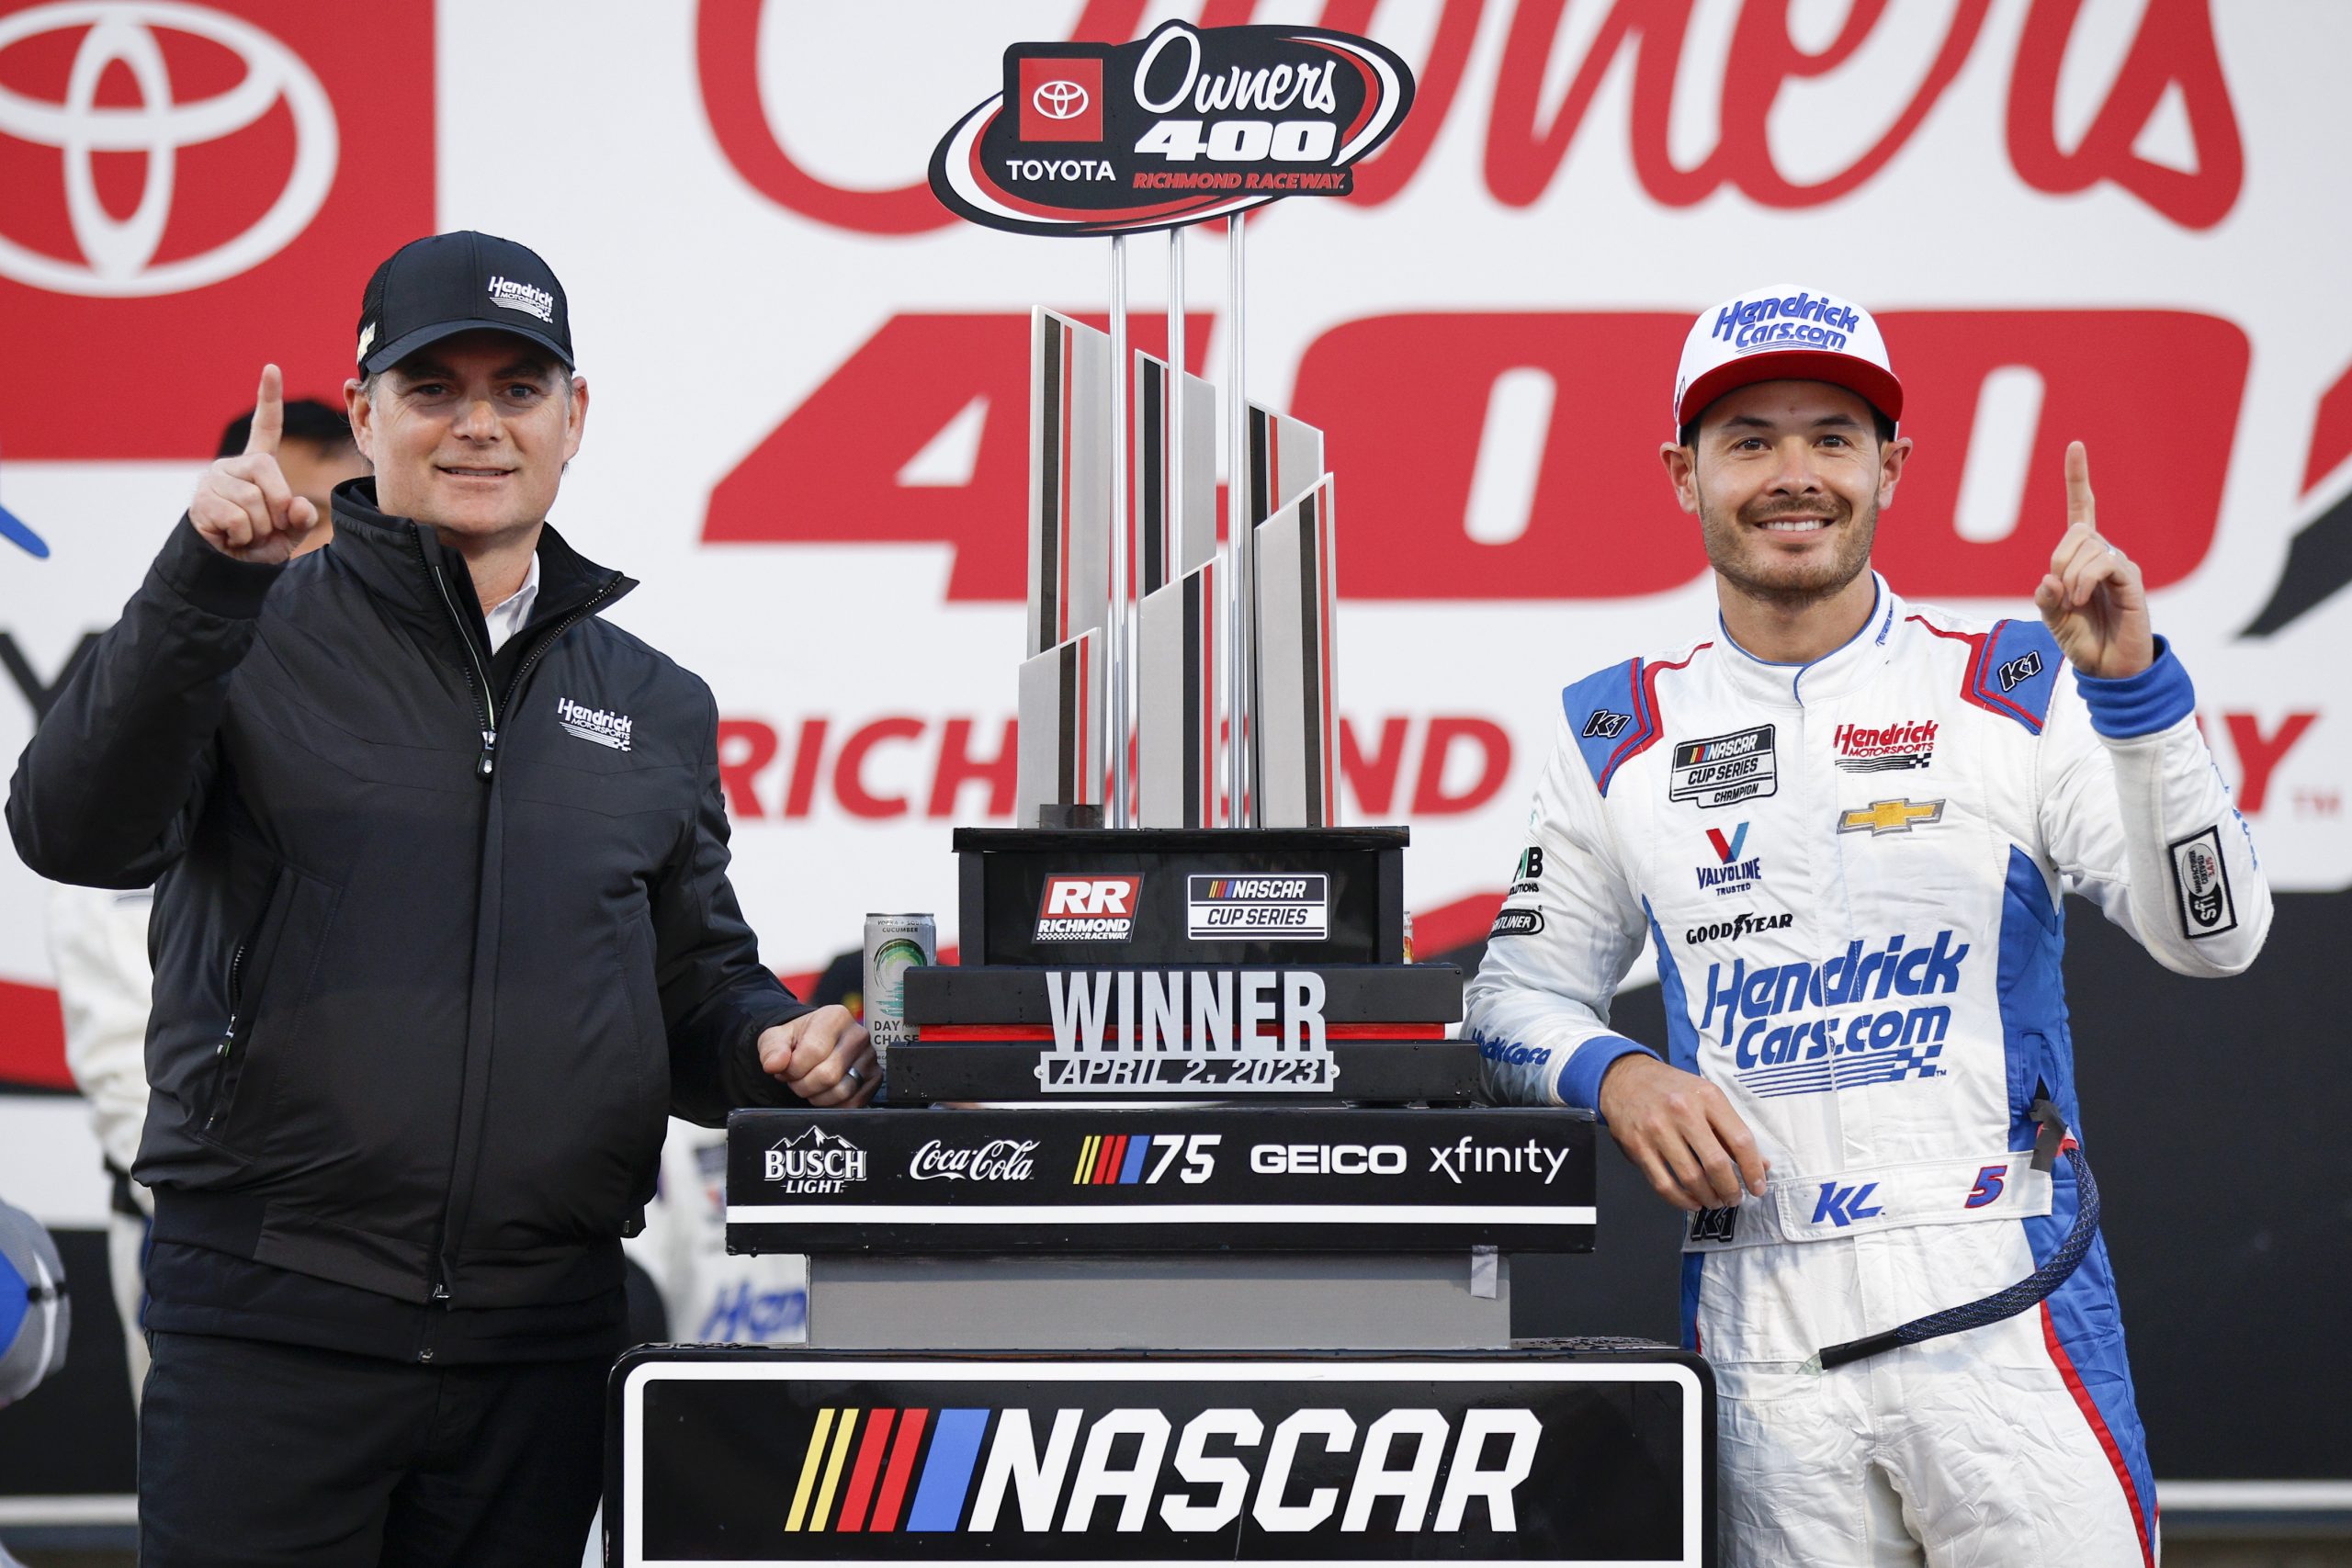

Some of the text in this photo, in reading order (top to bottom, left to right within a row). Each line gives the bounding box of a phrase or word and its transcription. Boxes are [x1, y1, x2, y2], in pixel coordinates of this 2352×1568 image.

[1134, 26, 1337, 114] Owners
[1135, 120, 1337, 161] 400
[1006, 160, 1116, 181] TOYOTA
[1133, 173, 1344, 189] RICHMOND RACEWAY
[488, 276, 553, 308] Hendrick
[500, 292, 552, 314] MOTORSPORTS
[1712, 292, 1860, 342] Hendrick
[1736, 322, 1847, 350] Cars.com
[1998, 650, 2041, 692] K1
[558, 697, 633, 732] Hendrick
[571, 718, 630, 739] MOTORSPORTS
[1582, 709, 1632, 739] K1
[1709, 734, 1758, 761] NASCAR
[1835, 720, 1939, 756] Hendrick
[1848, 742, 1934, 758] MOTORSPORTS
[1688, 758, 1758, 785] CUP SERIES
[1713, 783, 1759, 804] CHAMPION
[1696, 857, 1761, 890] VALVOLINE
[1047, 881, 1131, 915] RR
[1232, 880, 1307, 898] NASCAR
[1715, 883, 1751, 897] TRUSTED
[1207, 908, 1308, 925] CUP SERIES
[2194, 895, 2216, 919] sfi
[1038, 919, 1131, 933] RICHMOND
[1084, 932, 1129, 941] RACEWAY
[1686, 912, 1793, 944] GOODYEAR
[1700, 930, 1970, 1047] Hendrick
[874, 1021, 900, 1032] DAY
[1046, 972, 1328, 1051] WINNER
[1736, 1006, 1951, 1069] Cars.com
[1057, 1059, 1319, 1085] APRIL 2, 2023
[764, 1149, 867, 1181] BUSCH
[910, 1140, 1040, 1181] Coca-Cola
[1146, 1134, 1222, 1184] 75
[1250, 1145, 1408, 1175] GEICO
[1429, 1135, 1570, 1184] xfinity
[786, 1179, 844, 1194] LIGHT
[1964, 1165, 2008, 1209] 5
[966, 1407, 1544, 1533] NASCAR
